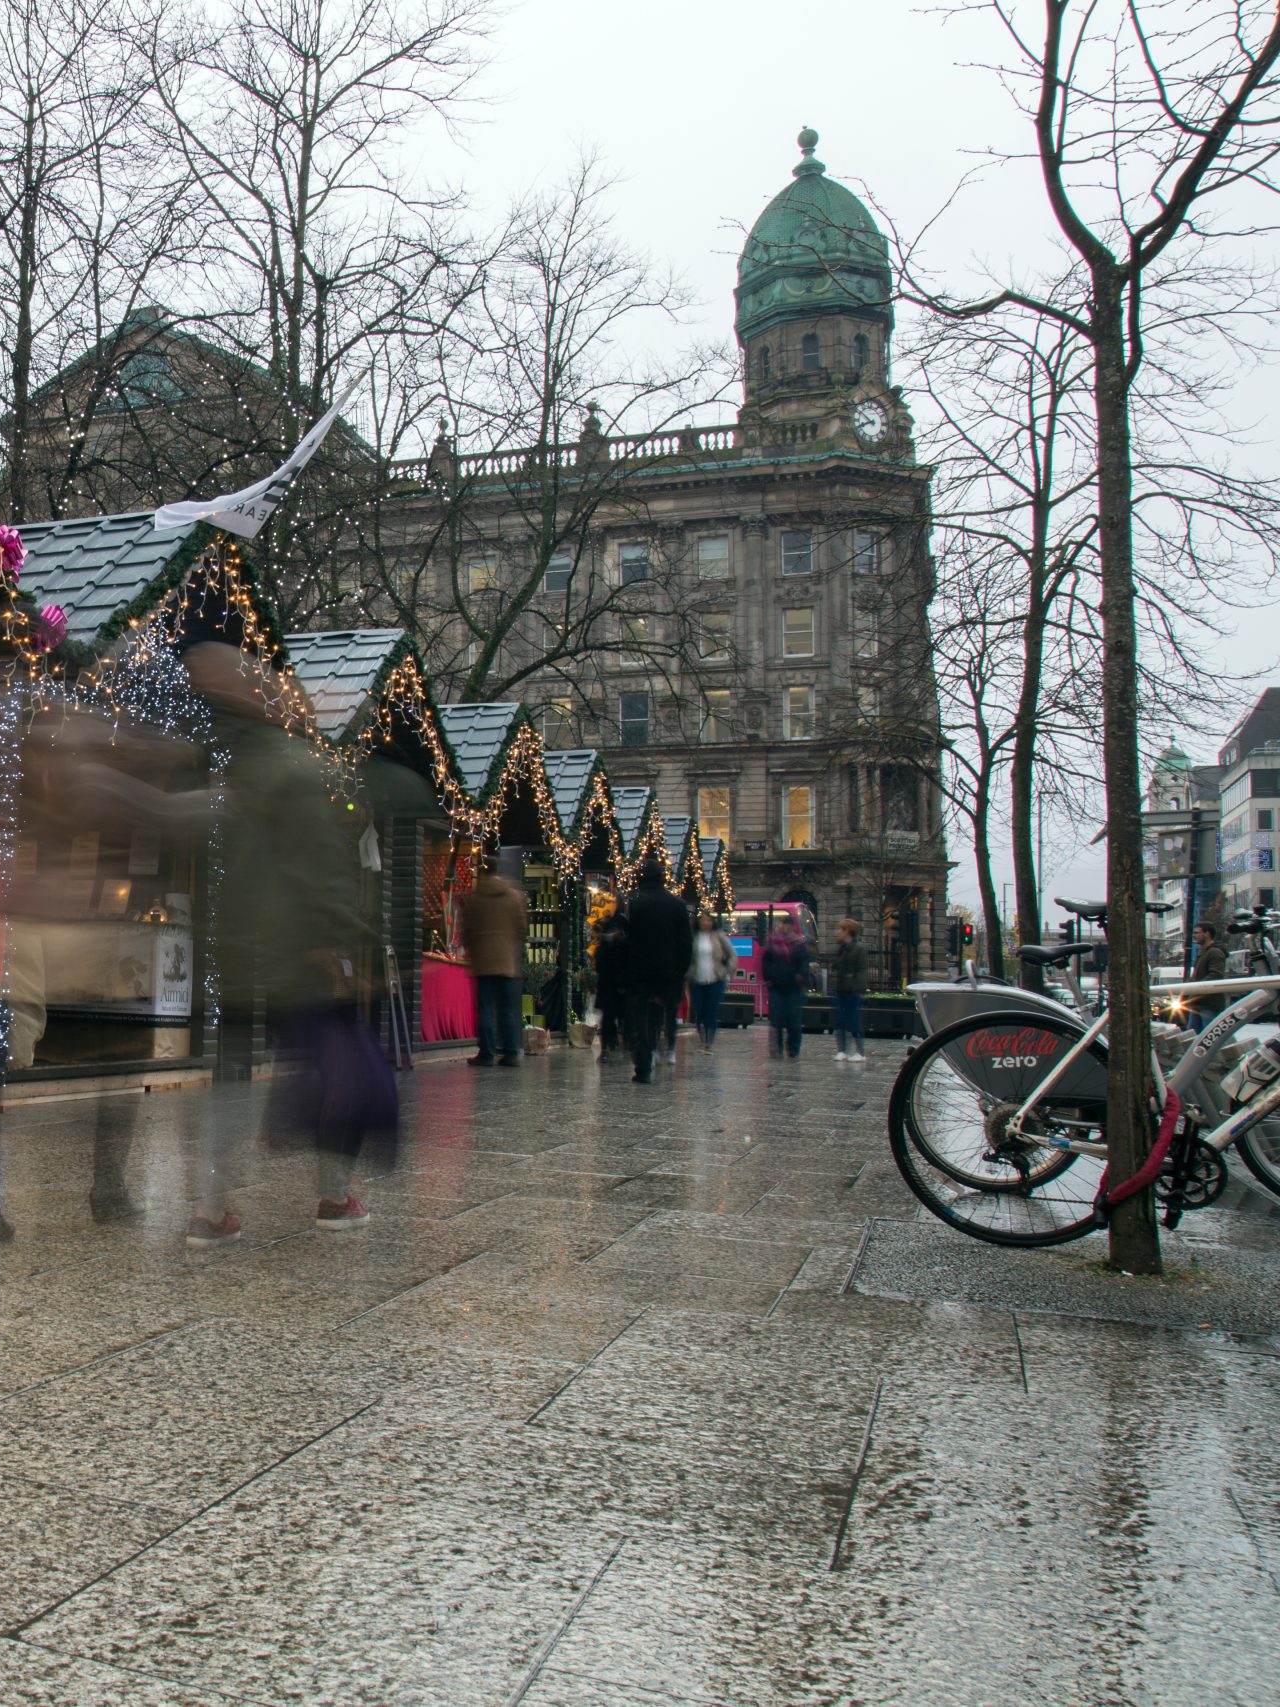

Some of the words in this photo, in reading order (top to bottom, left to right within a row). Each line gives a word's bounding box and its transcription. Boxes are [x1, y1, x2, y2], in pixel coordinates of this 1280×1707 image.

[160, 985, 189, 1003] Airmid
[1202, 1016, 1236, 1047] 82955
[992, 1056, 1038, 1069] zero
